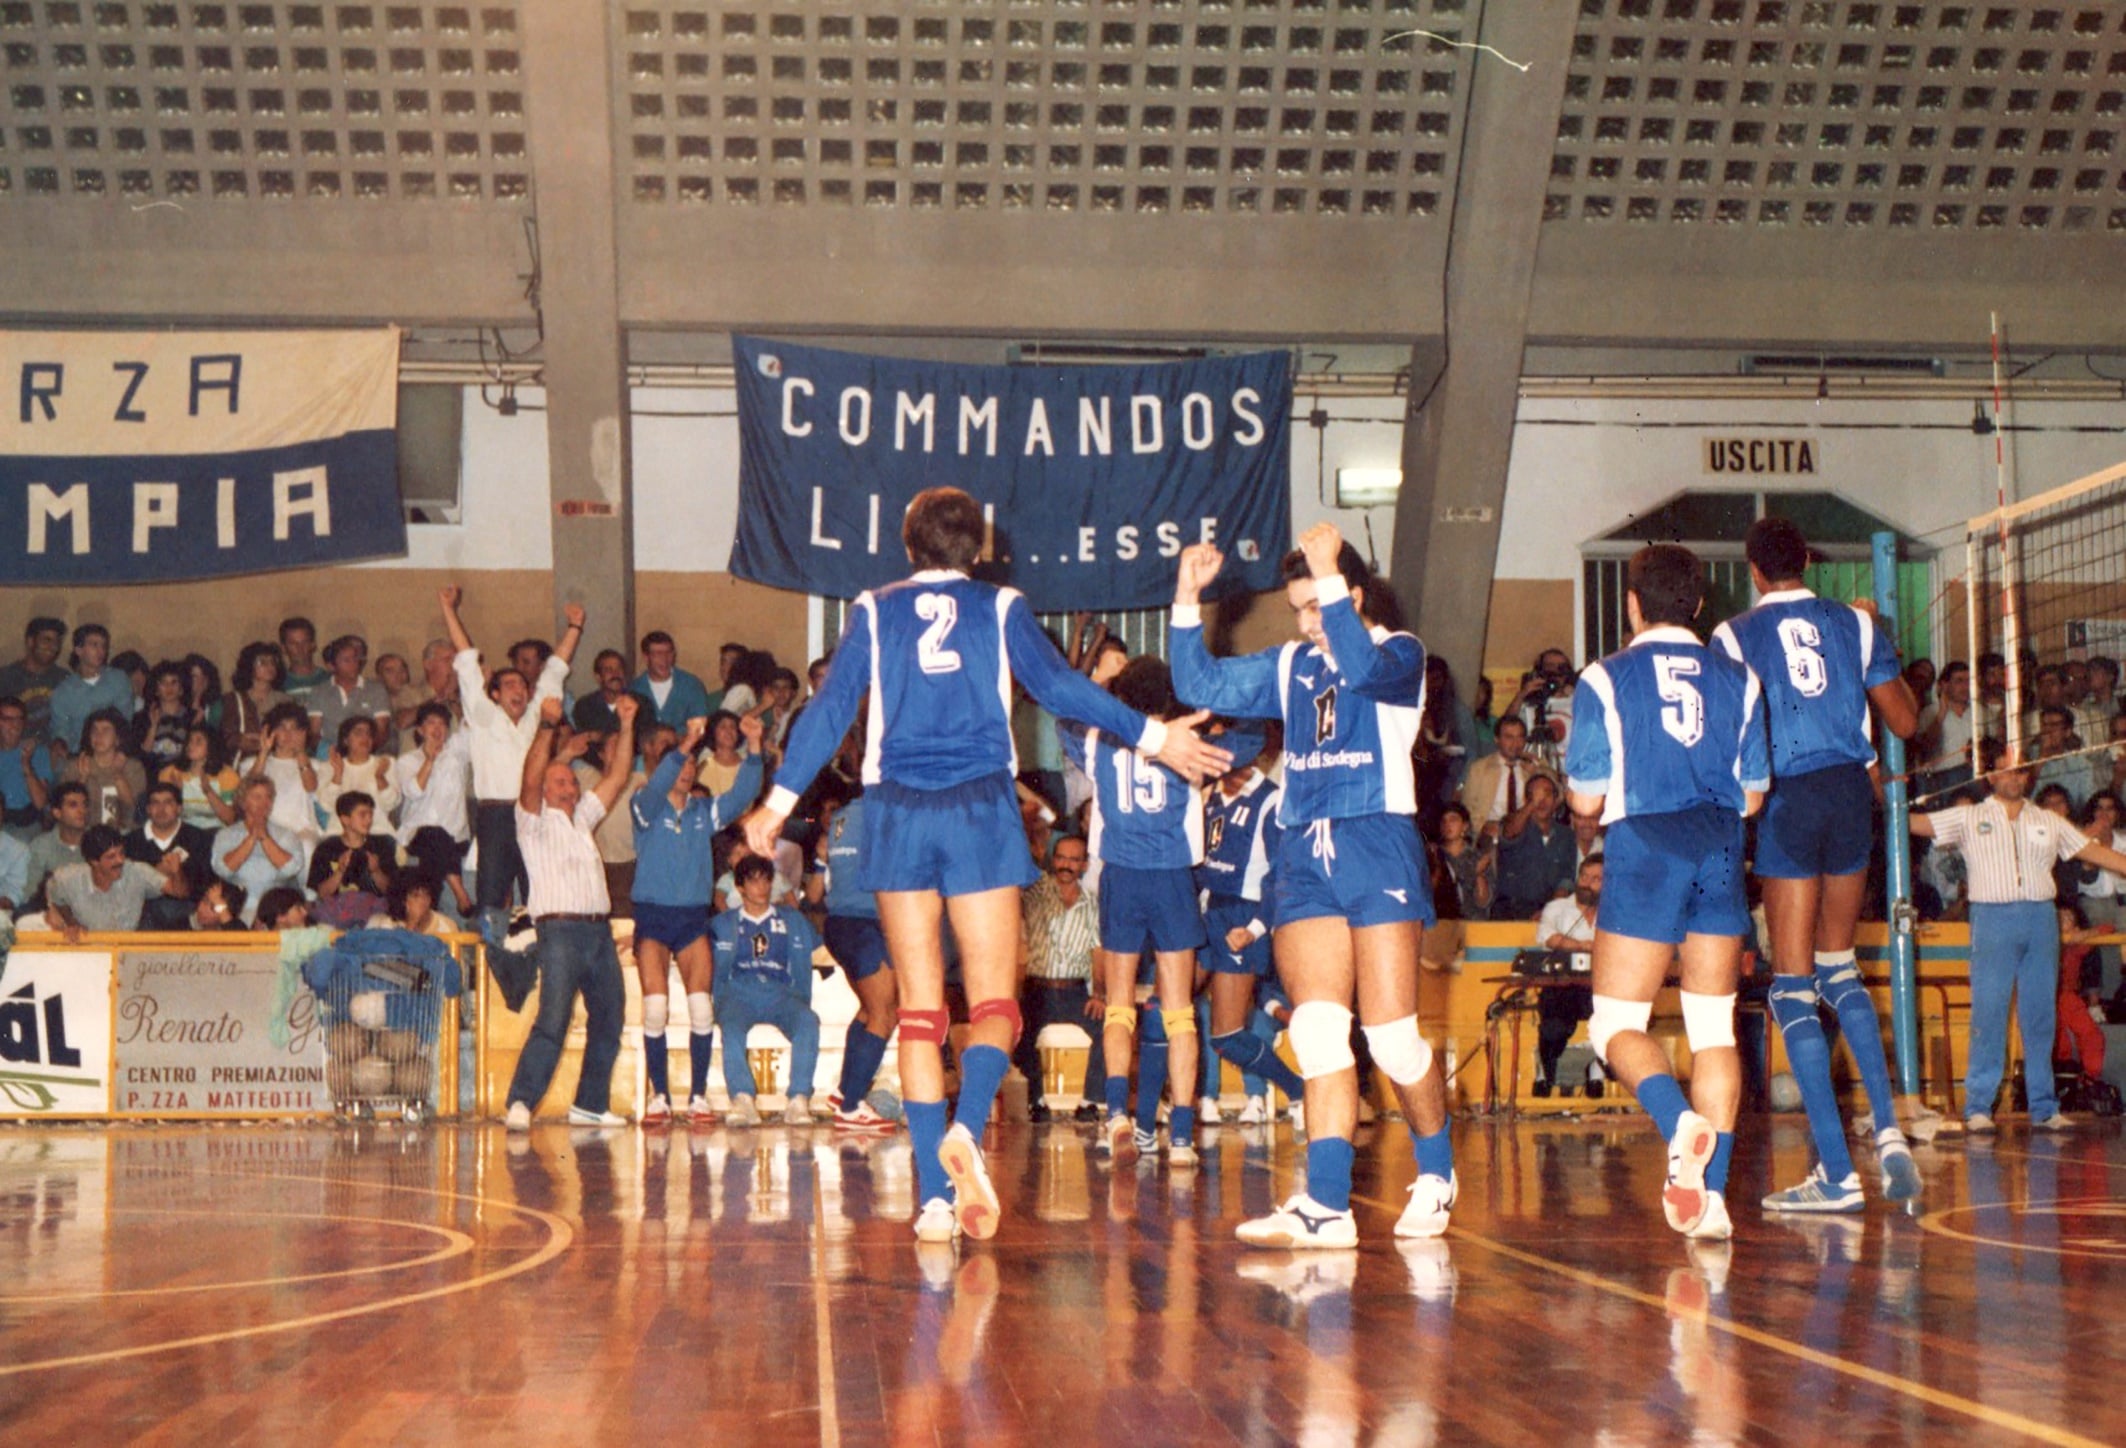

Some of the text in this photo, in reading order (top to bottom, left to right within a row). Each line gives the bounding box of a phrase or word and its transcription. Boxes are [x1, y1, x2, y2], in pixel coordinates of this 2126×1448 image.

[19, 354, 242, 423] RZA
[781, 376, 1266, 457] COMMANDOS
[1710, 440, 1814, 473] USCITA
[27, 465, 331, 553] MPIA
[914, 592, 961, 674] 2
[1777, 618, 1827, 698] 6
[1652, 654, 1704, 748] 5
[1112, 747, 1167, 813] 15
[117, 994, 243, 1043] Renato
[127, 1066, 323, 1083] CENTRO PREMIAZIONI
[207, 1091, 313, 1109] MATTEOTTI
